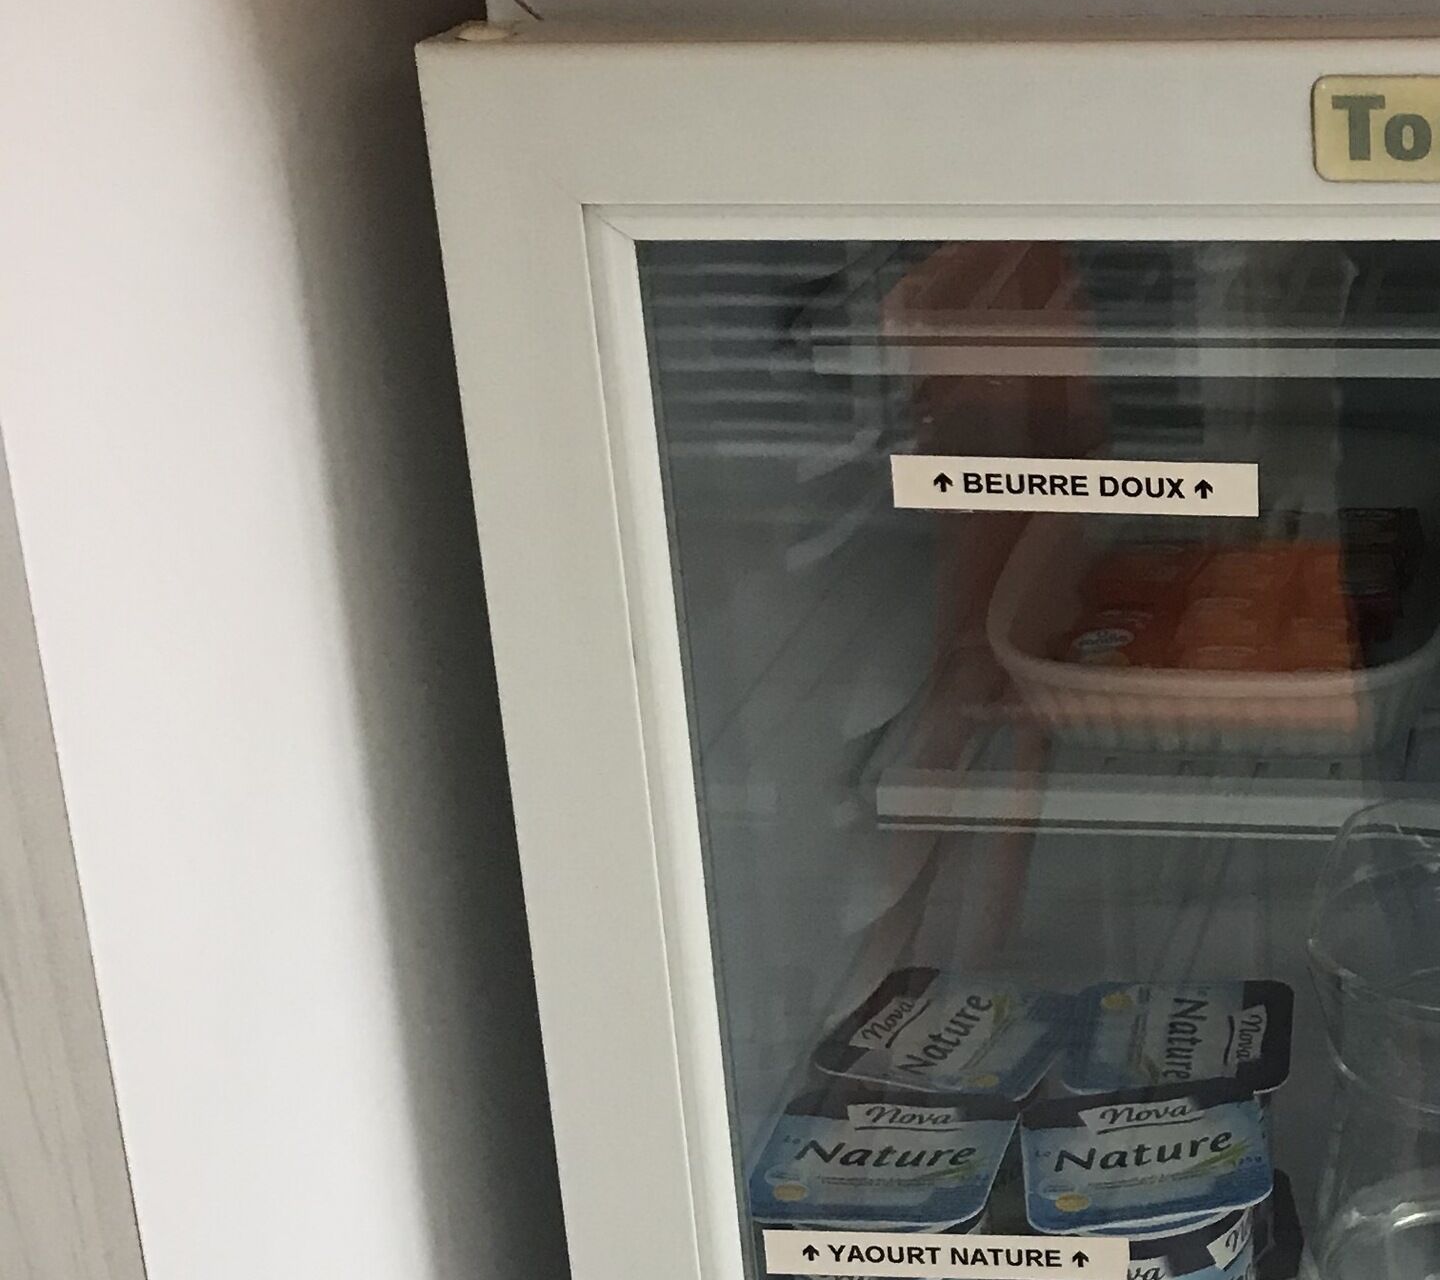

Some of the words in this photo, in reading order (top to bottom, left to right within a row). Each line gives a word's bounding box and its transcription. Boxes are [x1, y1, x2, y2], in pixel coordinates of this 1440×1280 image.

[962, 472, 1089, 498] BEURRE
[1099, 476, 1186, 500] DOUX
[896, 992, 994, 1077] Nature
[1162, 996, 1210, 1080] Nature
[866, 1105, 952, 1126] Nova
[1100, 1102, 1193, 1125] Nova
[794, 1139, 978, 1168] Nature
[1053, 1131, 1233, 1172] Nature
[826, 1243, 942, 1267] YAOURT
[951, 1246, 1064, 1268] NATURE
